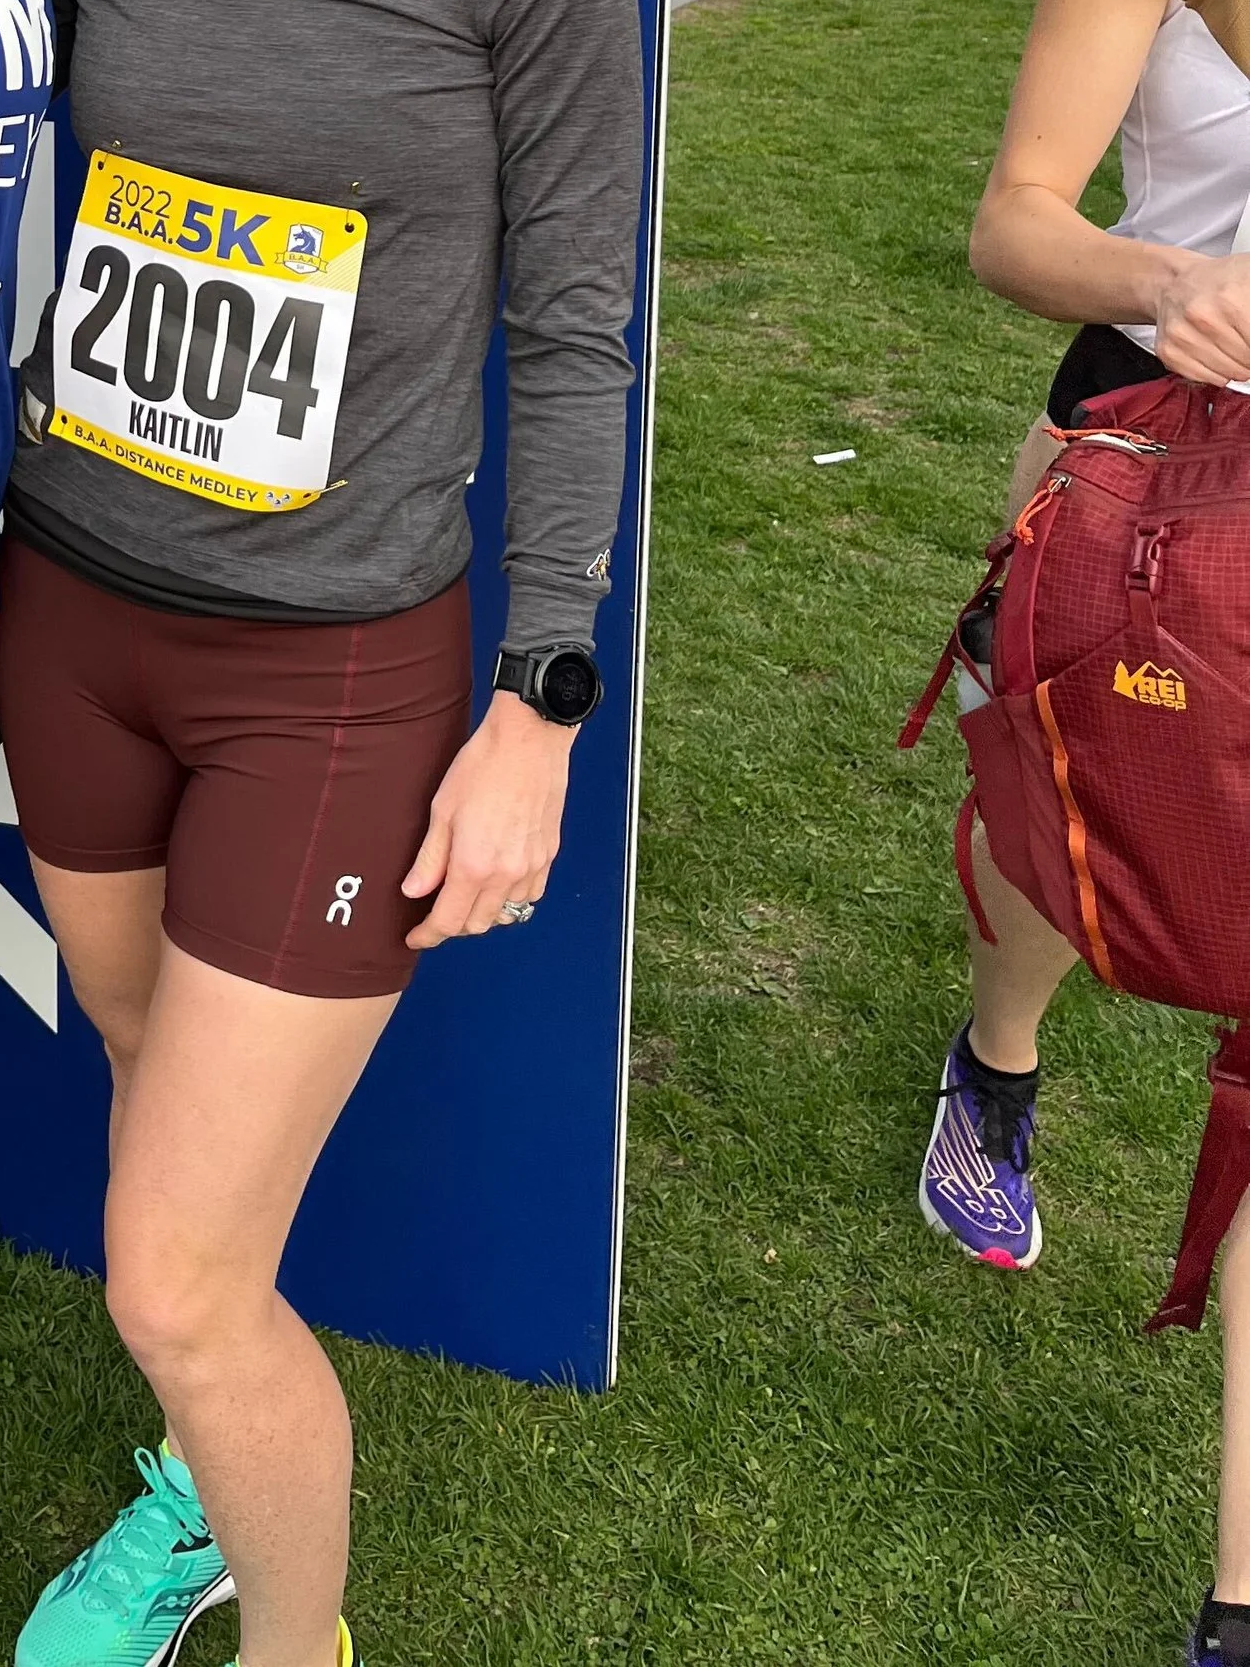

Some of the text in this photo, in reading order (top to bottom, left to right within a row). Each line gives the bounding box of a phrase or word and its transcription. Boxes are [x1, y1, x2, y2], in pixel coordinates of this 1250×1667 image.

[109, 175, 173, 219] 2022
[104, 199, 271, 267] B.A.A. 5K
[70, 245, 324, 440] 2004
[129, 400, 224, 463] KAITLIN
[74, 425, 259, 504] B.A.A. DISTANCE MEDLEY
[1137, 677, 1186, 701] REI
